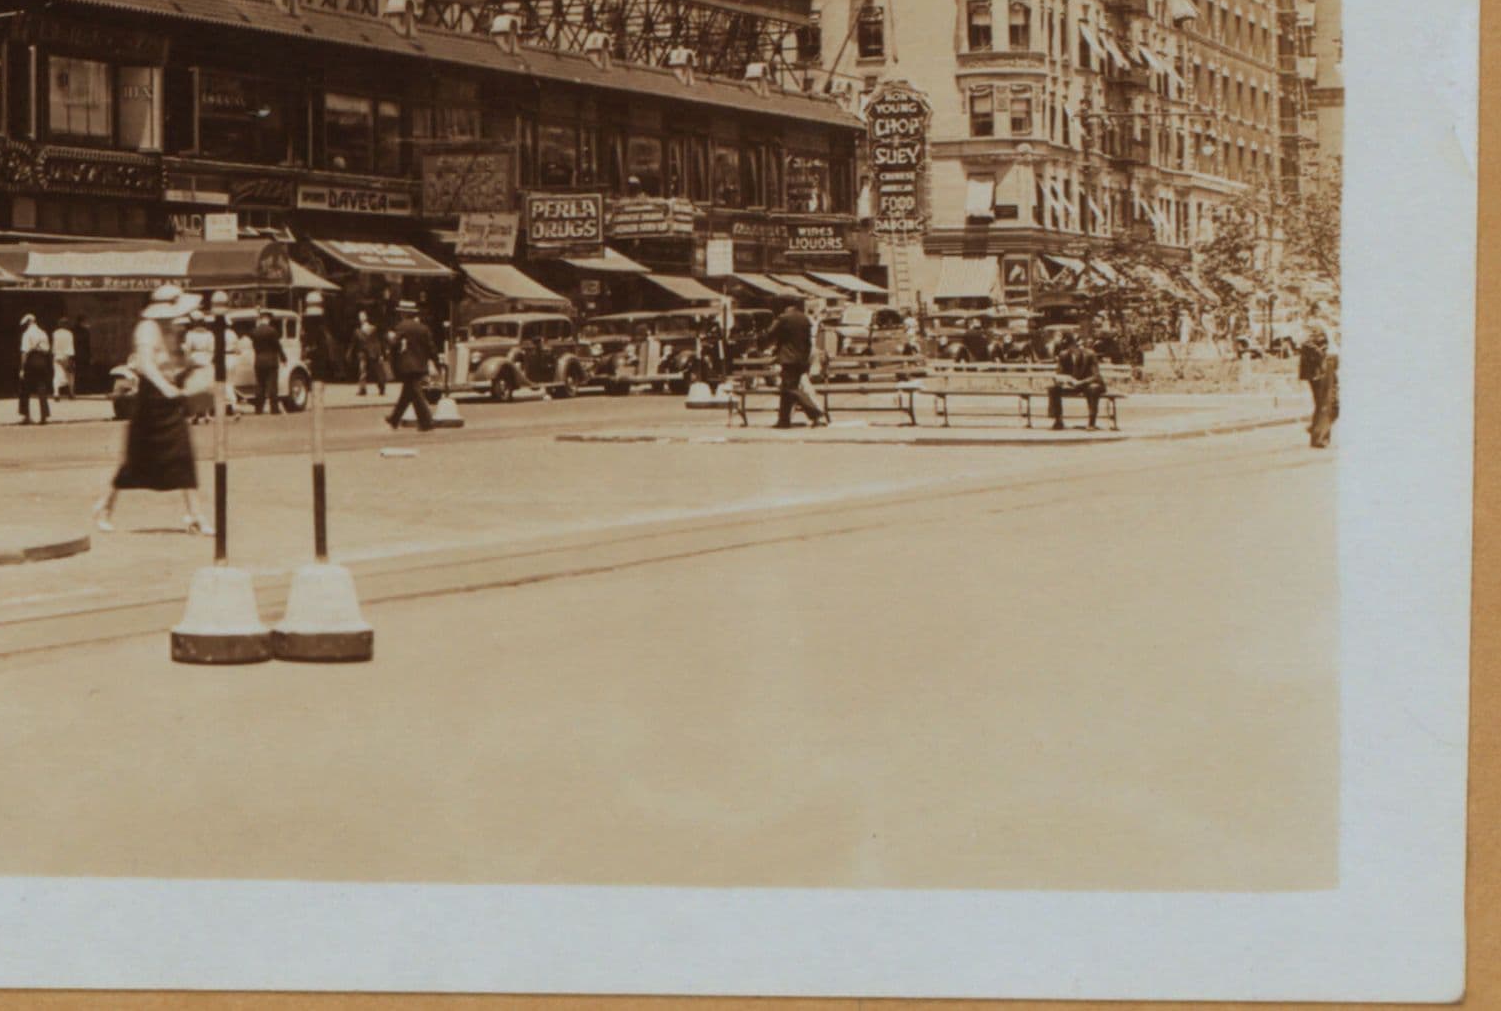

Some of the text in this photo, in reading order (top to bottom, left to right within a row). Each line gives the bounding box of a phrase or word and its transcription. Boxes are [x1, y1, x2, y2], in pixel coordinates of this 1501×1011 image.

[875, 102, 918, 114] YOUNG
[875, 118, 920, 136] CHOP
[875, 145, 920, 164] SUEY
[328, 189, 388, 212] DAVEGA
[531, 199, 597, 219] PERLA
[880, 196, 916, 211] FOOD
[531, 220, 597, 239] DRUGS
[788, 237, 844, 250] LIQUORS
